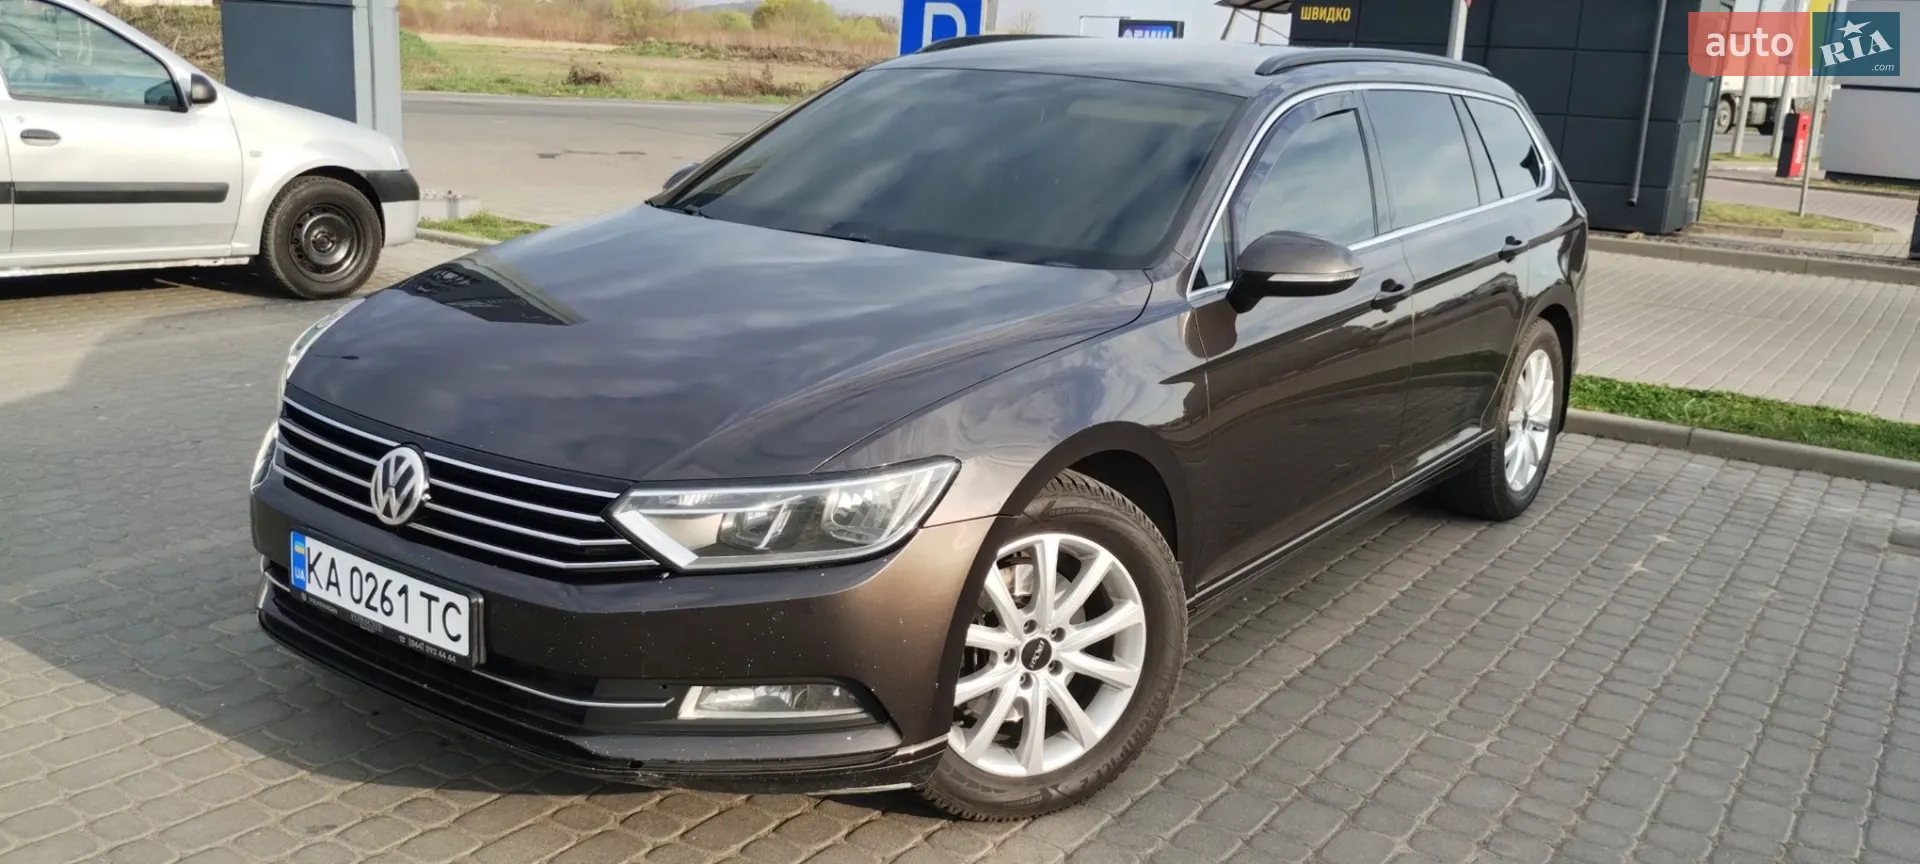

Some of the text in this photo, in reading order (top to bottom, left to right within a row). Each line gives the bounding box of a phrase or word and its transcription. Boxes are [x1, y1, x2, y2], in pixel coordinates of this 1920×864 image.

[1300, 6, 1351, 24] ШВИДКО
[295, 566, 306, 582] UA
[307, 547, 342, 597] KA
[350, 566, 409, 624] 0261
[420, 591, 462, 642] TC
